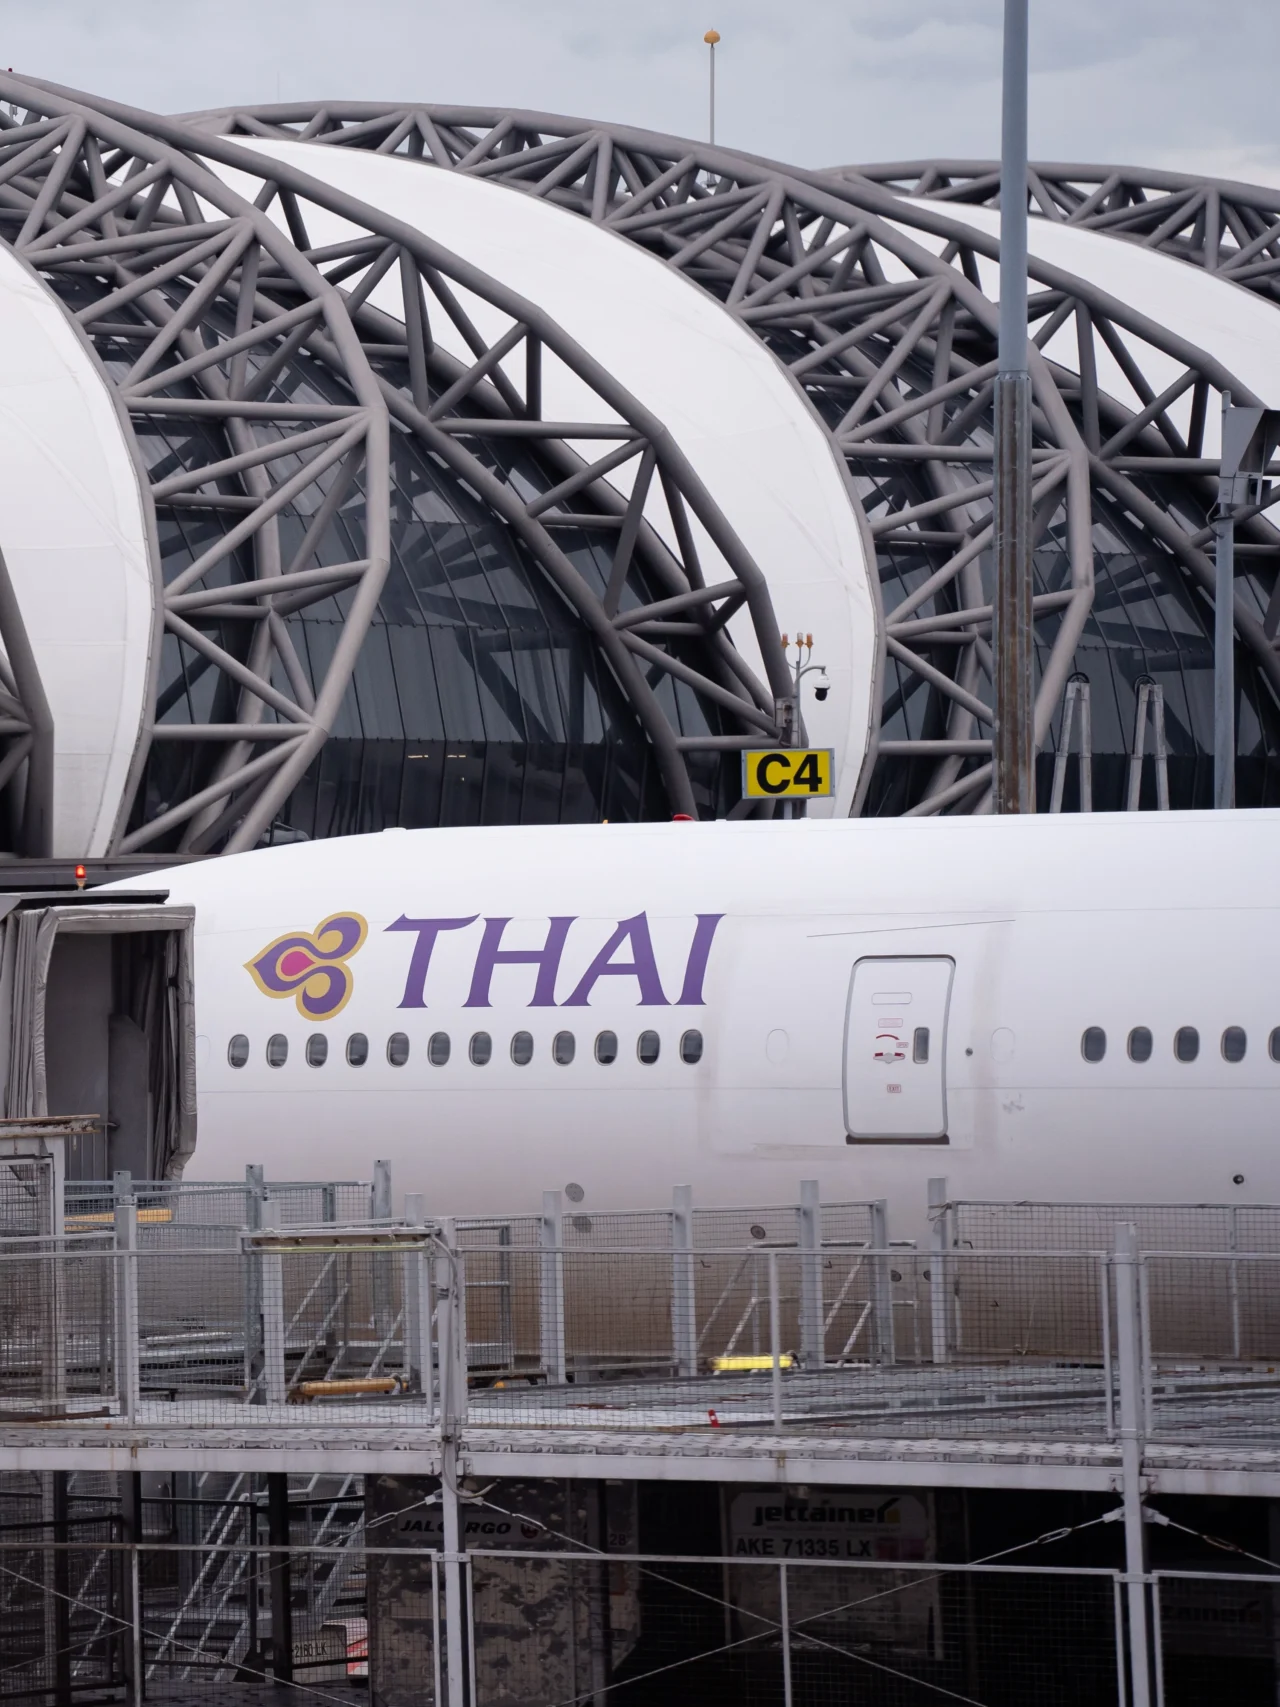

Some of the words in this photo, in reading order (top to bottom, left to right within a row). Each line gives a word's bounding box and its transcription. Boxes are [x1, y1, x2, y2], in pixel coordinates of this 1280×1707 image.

[756, 753, 822, 794] C4
[382, 910, 727, 1009] THAI
[736, 1538, 775, 1556] AKE
[782, 1538, 839, 1556] 71335
[846, 1540, 872, 1557] LX
